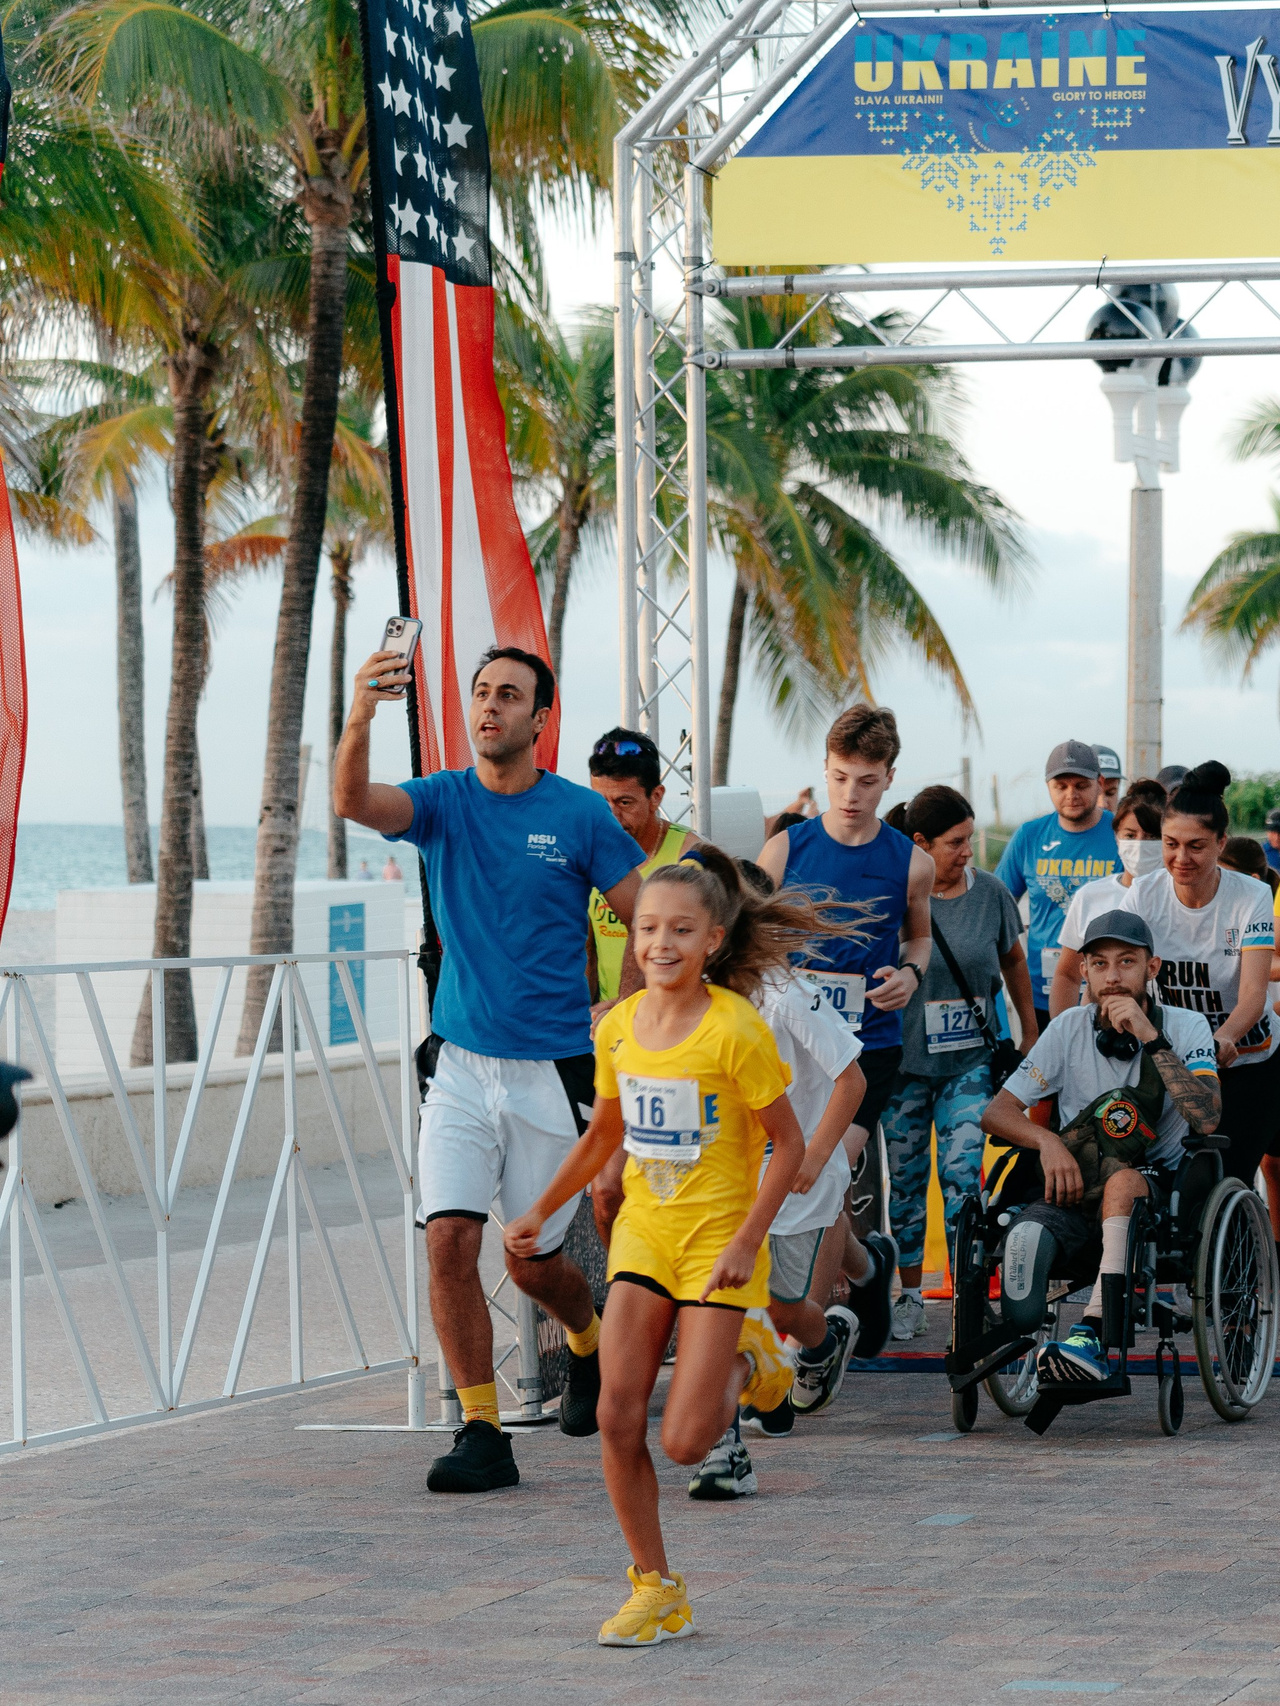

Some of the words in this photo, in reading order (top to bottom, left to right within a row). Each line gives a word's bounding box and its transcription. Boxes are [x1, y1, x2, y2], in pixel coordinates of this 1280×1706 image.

[854, 96, 891, 105] SLAVA
[1052, 92, 1087, 101] GLORY
[1089, 91, 1102, 100] TO
[1105, 91, 1147, 100] HEROES!
[527, 834, 557, 845] NSU
[1160, 960, 1210, 988] RUN
[942, 1010, 972, 1031] 127
[635, 1095, 665, 1127] 16
